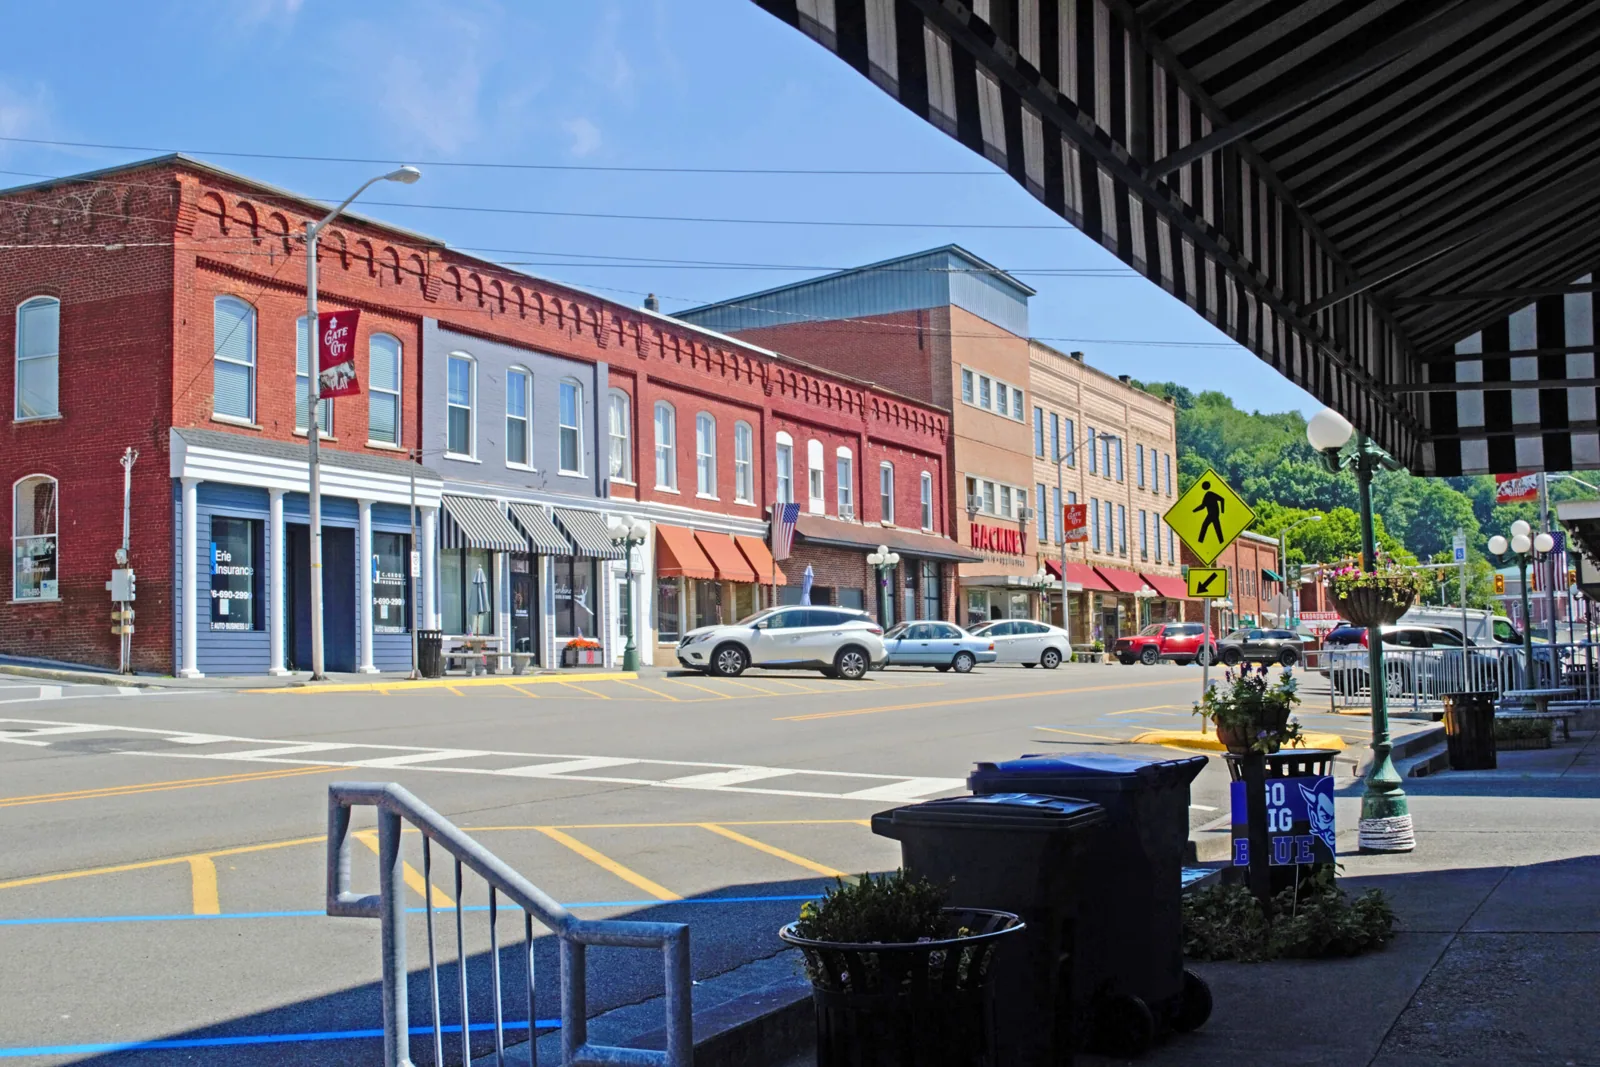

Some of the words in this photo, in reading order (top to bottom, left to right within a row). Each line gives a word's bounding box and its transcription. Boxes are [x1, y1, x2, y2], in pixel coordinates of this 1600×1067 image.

[325, 327, 348, 345] GATE
[331, 341, 347, 356] CITY
[331, 378, 348, 390] PLAY
[971, 523, 1027, 555] HACKNEY
[216, 550, 231, 562] Erie
[216, 565, 254, 575] Insurance
[1268, 807, 1293, 832] IG
[1233, 835, 1315, 866] BUE
